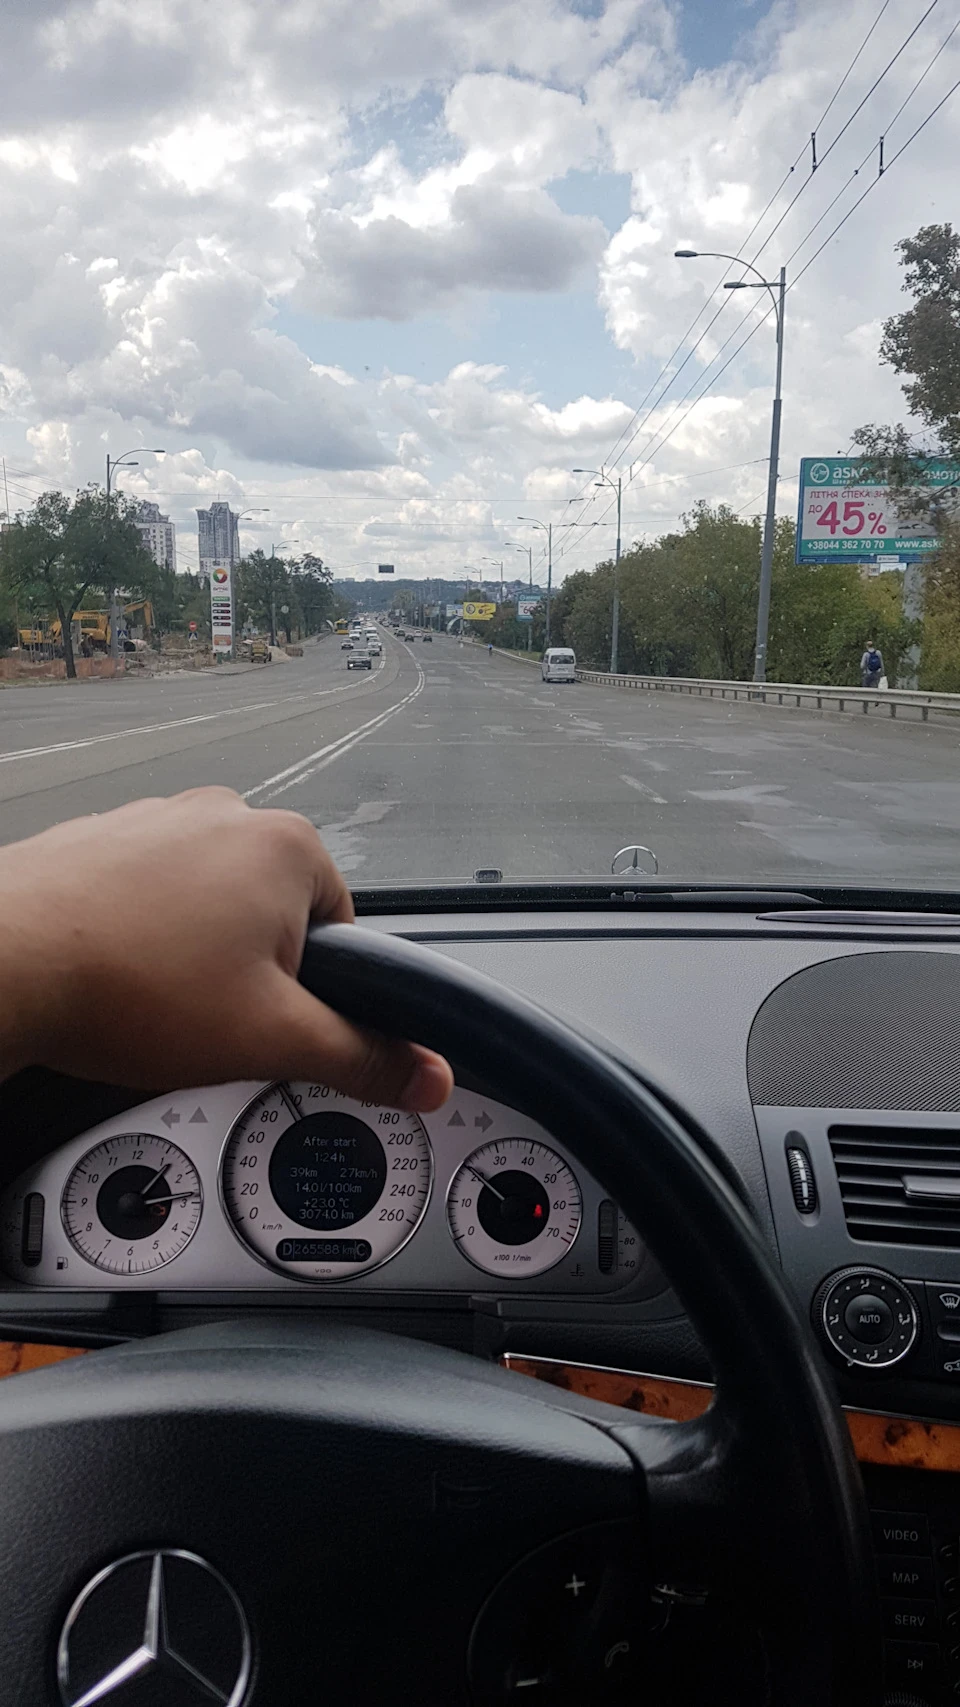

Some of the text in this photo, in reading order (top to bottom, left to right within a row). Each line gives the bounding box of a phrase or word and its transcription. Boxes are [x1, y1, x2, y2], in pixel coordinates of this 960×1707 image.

[841, 490, 870, 499] СПЕКА
[808, 504, 823, 514] ДО
[807, 540, 885, 550] +38044 362 70 70
[307, 1085, 330, 1098] 120
[260, 1110, 279, 1123] 80
[378, 1112, 400, 1125] 180
[247, 1131, 265, 1144] 60
[303, 1136, 357, 1147] After start
[387, 1133, 414, 1146] 200
[132, 1150, 144, 1160] 12
[108, 1157, 118, 1166] 11
[160, 1157, 165, 1166] 1
[239, 1155, 258, 1168] 40
[391, 1158, 419, 1171] 220
[493, 1156, 507, 1166] 30
[521, 1156, 535, 1166] 40
[87, 1173, 99, 1184] 10
[175, 1174, 184, 1184] 2
[543, 1173, 558, 1184] 50
[240, 1182, 259, 1196] 20
[389, 1184, 416, 1197] 240
[81, 1197, 88, 1207] 9
[179, 1198, 188, 1209] 3
[461, 1198, 472, 1208] 10
[552, 1200, 567, 1211] 60
[249, 1206, 259, 1220] 0
[341, 1208, 355, 1219] km
[378, 1208, 405, 1222] 260
[85, 1222, 93, 1232] 8
[171, 1223, 179, 1232] 4
[467, 1226, 475, 1236] 0
[546, 1228, 560, 1238] 70
[104, 1240, 112, 1249] 7
[152, 1240, 159, 1250] 5
[127, 1246, 134, 1256] 6
[494, 1254, 531, 1262] x100 1/min
[624, 1259, 636, 1269] 40
[860, 1315, 881, 1324] AUTO
[883, 1528, 919, 1542] VIDEO
[892, 1571, 919, 1585] MAP
[895, 1614, 925, 1627] SERV
